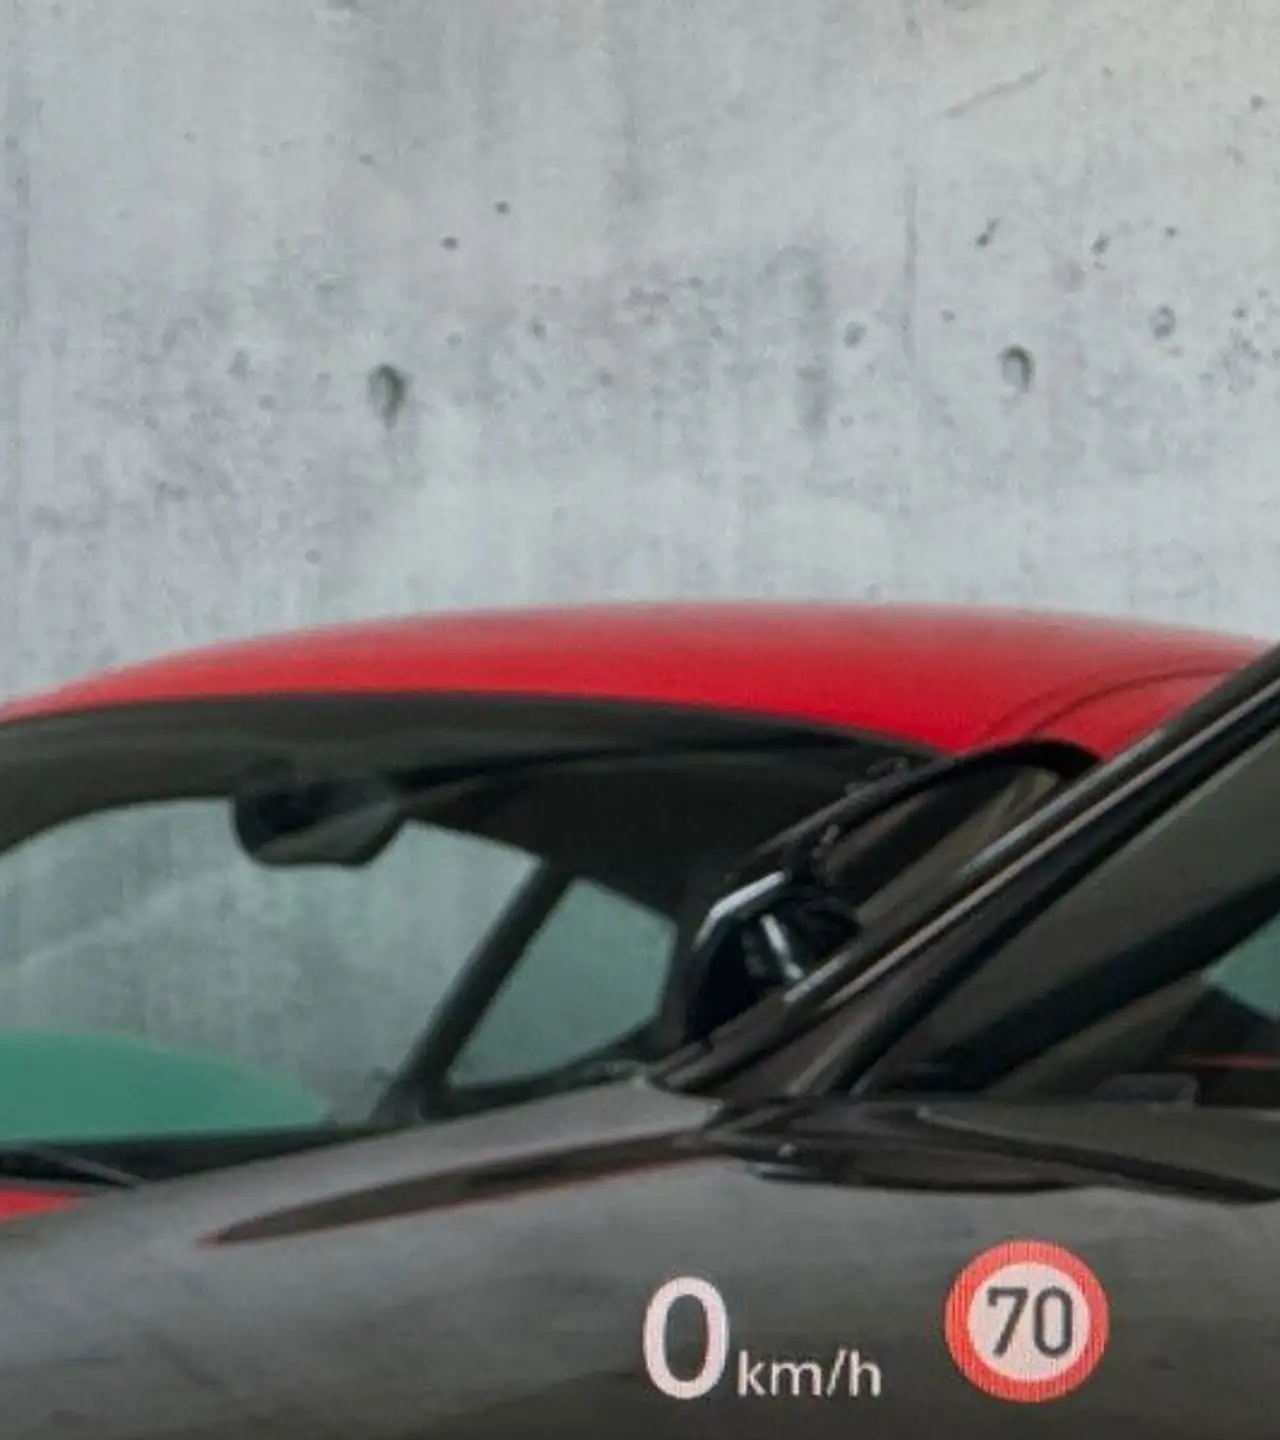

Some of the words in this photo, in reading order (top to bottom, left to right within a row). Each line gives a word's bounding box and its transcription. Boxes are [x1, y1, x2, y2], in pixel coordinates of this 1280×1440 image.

[643, 1276, 729, 1399] 0
[738, 1349, 881, 1396] km/h
[987, 1286, 1074, 1358] 70
